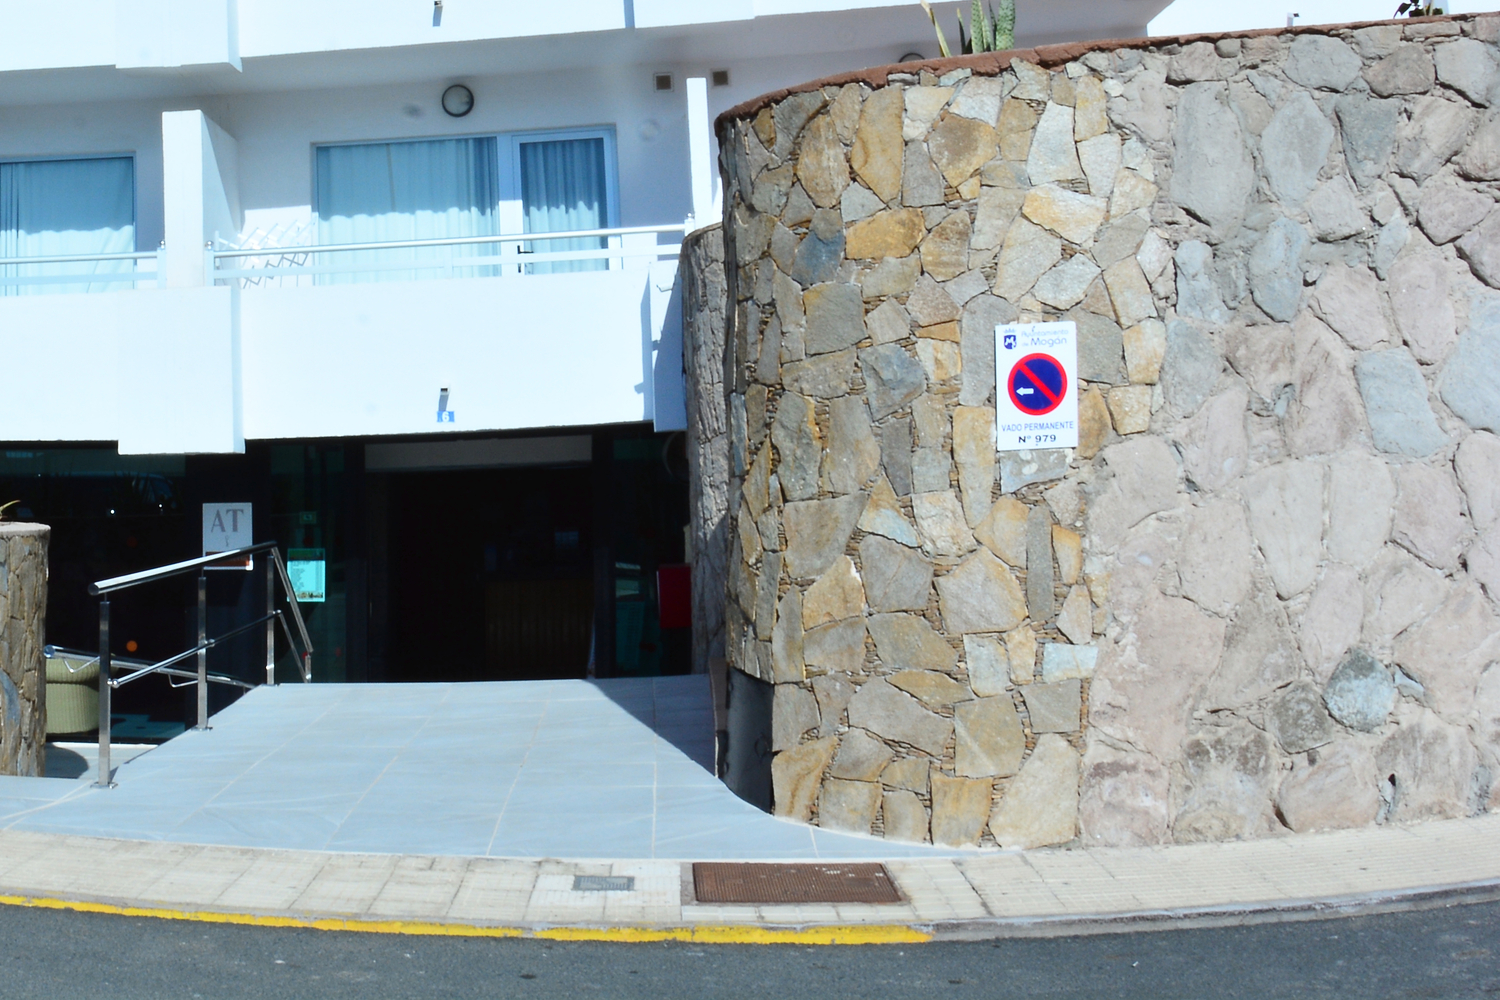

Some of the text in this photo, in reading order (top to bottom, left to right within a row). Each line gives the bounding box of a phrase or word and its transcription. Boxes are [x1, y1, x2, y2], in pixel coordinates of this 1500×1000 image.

[1030, 336, 1067, 348] Mogán
[442, 411, 450, 422] 6
[1001, 421, 1074, 432] VADO PERMANENTE
[1035, 433, 1057, 443] 979
[210, 508, 245, 533] AT
